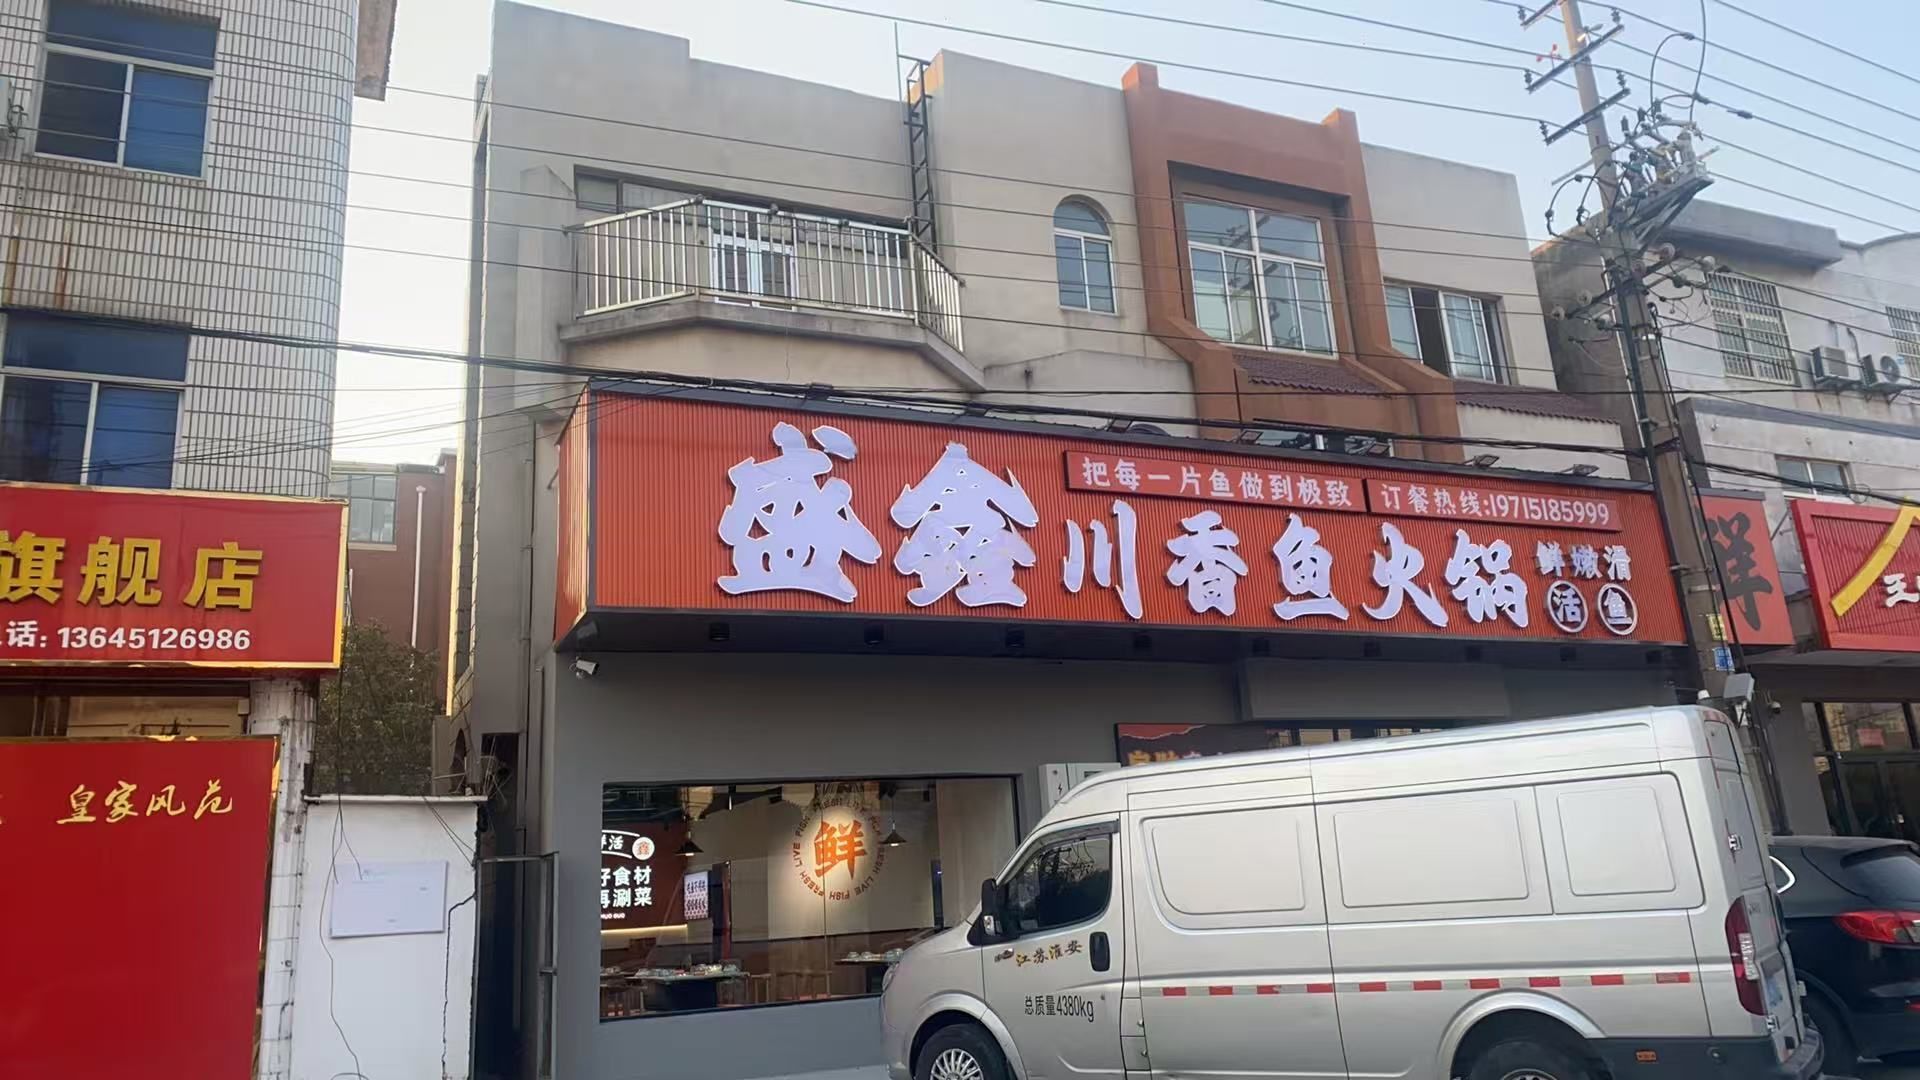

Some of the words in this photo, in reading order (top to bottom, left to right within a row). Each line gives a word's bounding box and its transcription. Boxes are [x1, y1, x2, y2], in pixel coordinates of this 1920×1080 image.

[1082, 456, 1353, 507] 把每一片鱼做到极致
[1381, 483, 1610, 525] 订餐热线:19715185999
[0, 530, 263, 611] 旗舰店
[1536, 540, 1632, 581] 鲜嫩滑
[1551, 585, 1635, 628] 活鱼
[1883, 573, 1920, 607] 王
[0, 620, 250, 650] 话:13645126986
[57, 779, 233, 824] 皇家风范
[814, 820, 868, 881] 鲜
[1016, 940, 1083, 967] 江苏淮安
[1024, 995, 1094, 1022] 总质量4380kg
